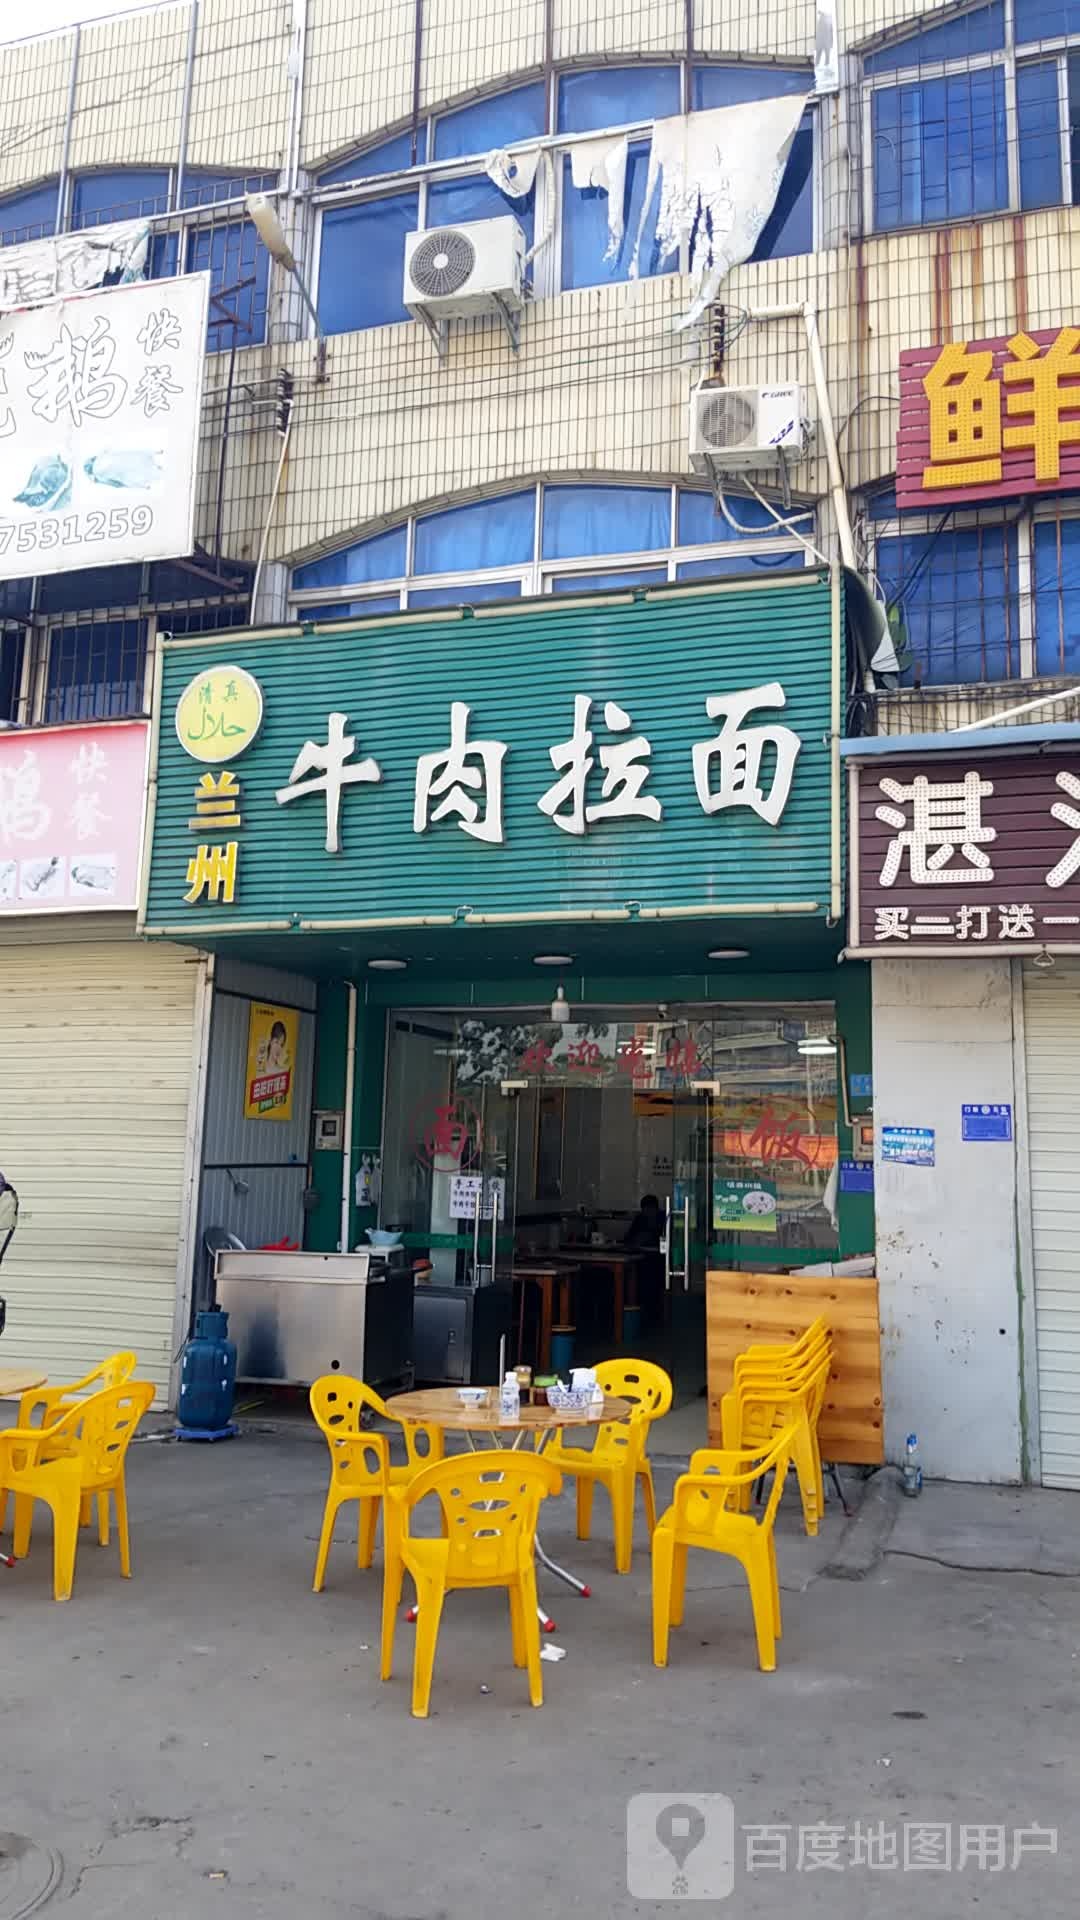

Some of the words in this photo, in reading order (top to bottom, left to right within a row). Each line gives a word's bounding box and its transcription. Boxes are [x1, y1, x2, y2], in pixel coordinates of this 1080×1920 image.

[130, 308, 184, 418] 快餐
[0, 504, 154, 554] 7531259
[198, 680, 239, 705] 清真
[187, 706, 247, 740] حلال
[275, 682, 802, 854] 牛肉拉面
[183, 770, 241, 904] 兰州
[874, 904, 1080, 940] 买二打送一
